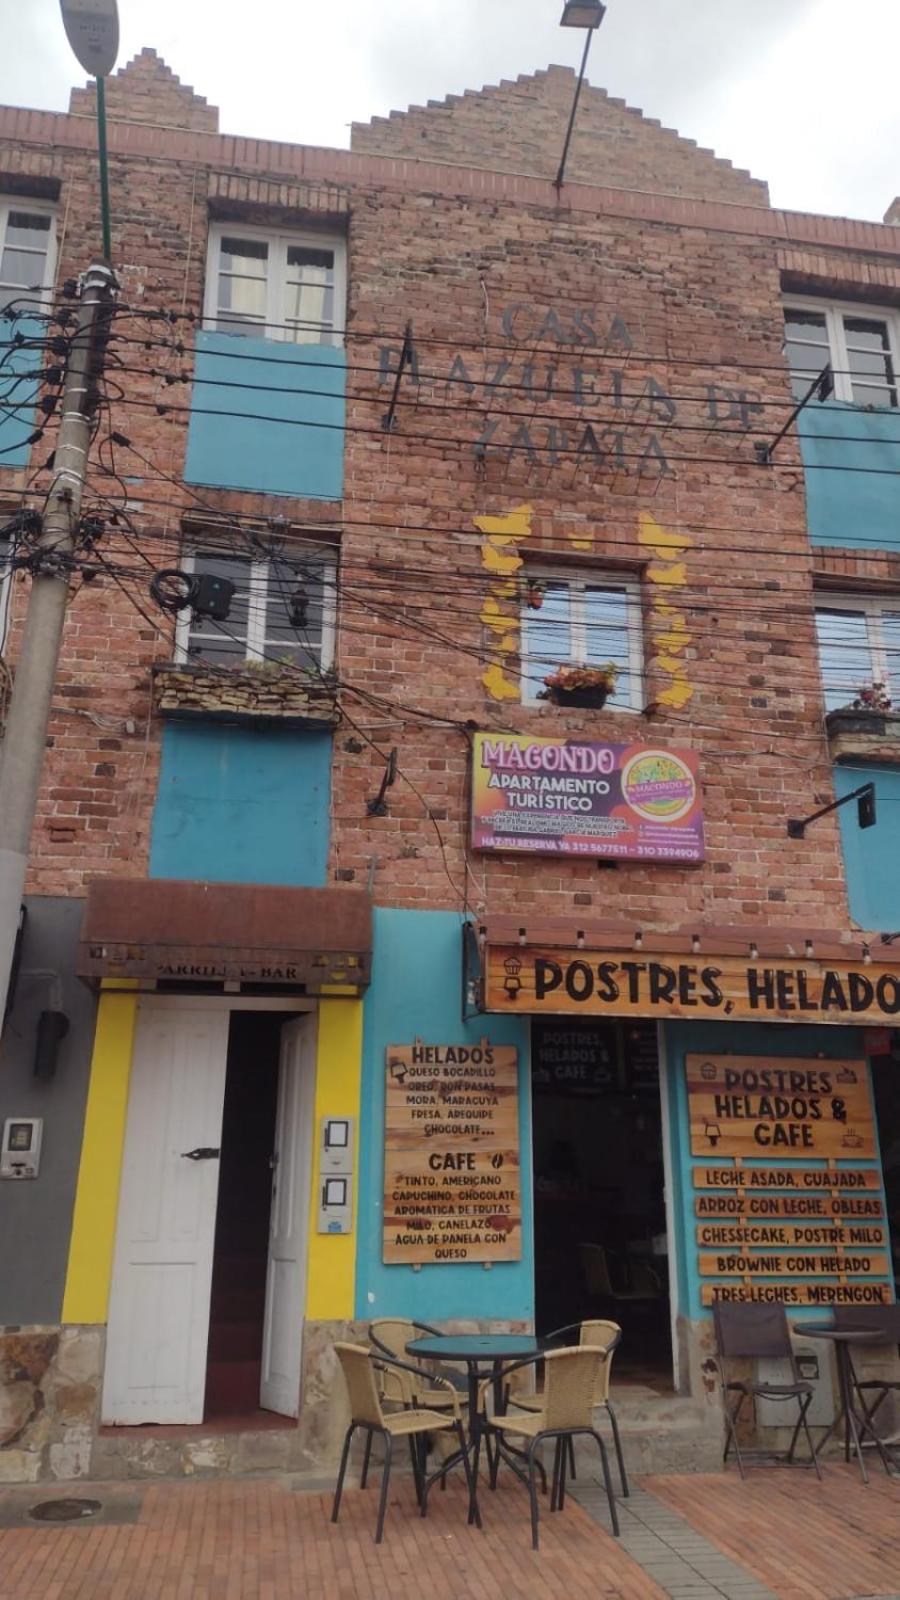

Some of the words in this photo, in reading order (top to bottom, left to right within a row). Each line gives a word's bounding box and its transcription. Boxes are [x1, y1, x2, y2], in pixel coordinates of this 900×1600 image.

[503, 302, 633, 350] CASA
[472, 420, 676, 478] ZAPATA
[489, 773, 610, 794] APARTAMENTO
[507, 790, 592, 811] TURÍSTICO
[518, 839, 558, 849] RESERVA
[260, 967, 297, 979] BAR
[534, 958, 735, 1014] POSTRES,
[747, 967, 900, 1014] HELADO
[412, 1046, 495, 1064] HELADOS
[539, 1048, 596, 1062] HELADOS
[409, 1067, 440, 1077] QUESO
[443, 1067, 496, 1077] BOCADILLO
[465, 1082, 495, 1092] PASAS
[724, 1068, 832, 1094] POSTRES
[443, 1096, 498, 1105] MARACUYA
[447, 1110, 494, 1119] AREQUIPE
[715, 1095, 822, 1120] HELADOS
[831, 1097, 847, 1125] &
[754, 1123, 814, 1147] CAFE
[429, 1153, 476, 1170] CAFE
[405, 1176, 438, 1187] TINTO,
[442, 1176, 501, 1185] AMERICANO
[706, 1171, 745, 1186] LECHE
[751, 1171, 799, 1188] ASADA,
[803, 1173, 866, 1187] CUAJADA
[458, 1191, 515, 1200] CHOCOLATE
[394, 1205, 455, 1215] AROMATICA
[458, 1206, 470, 1214] DE
[473, 1205, 511, 1214] FRUTAS
[699, 1198, 745, 1213] ARROZ
[750, 1199, 779, 1213] CON
[783, 1199, 827, 1216] LECHE,
[831, 1200, 881, 1215] OBLEAS
[395, 1235, 424, 1245] AGUA
[427, 1235, 440, 1244] DE
[442, 1234, 481, 1244] PANELA
[484, 1234, 506, 1243] CON
[702, 1228, 790, 1244] CHESSECAKE,
[795, 1229, 846, 1243] POSTRE
[850, 1229, 883, 1243] MILO
[435, 1249, 467, 1258] QUESO
[717, 1257, 782, 1272] BROWNIE
[786, 1257, 816, 1272] CON
[821, 1257, 871, 1272] HELADO
[712, 1287, 746, 1302] TRES
[751, 1287, 802, 1303] LECHES,
[807, 1287, 883, 1302] MERENGON
